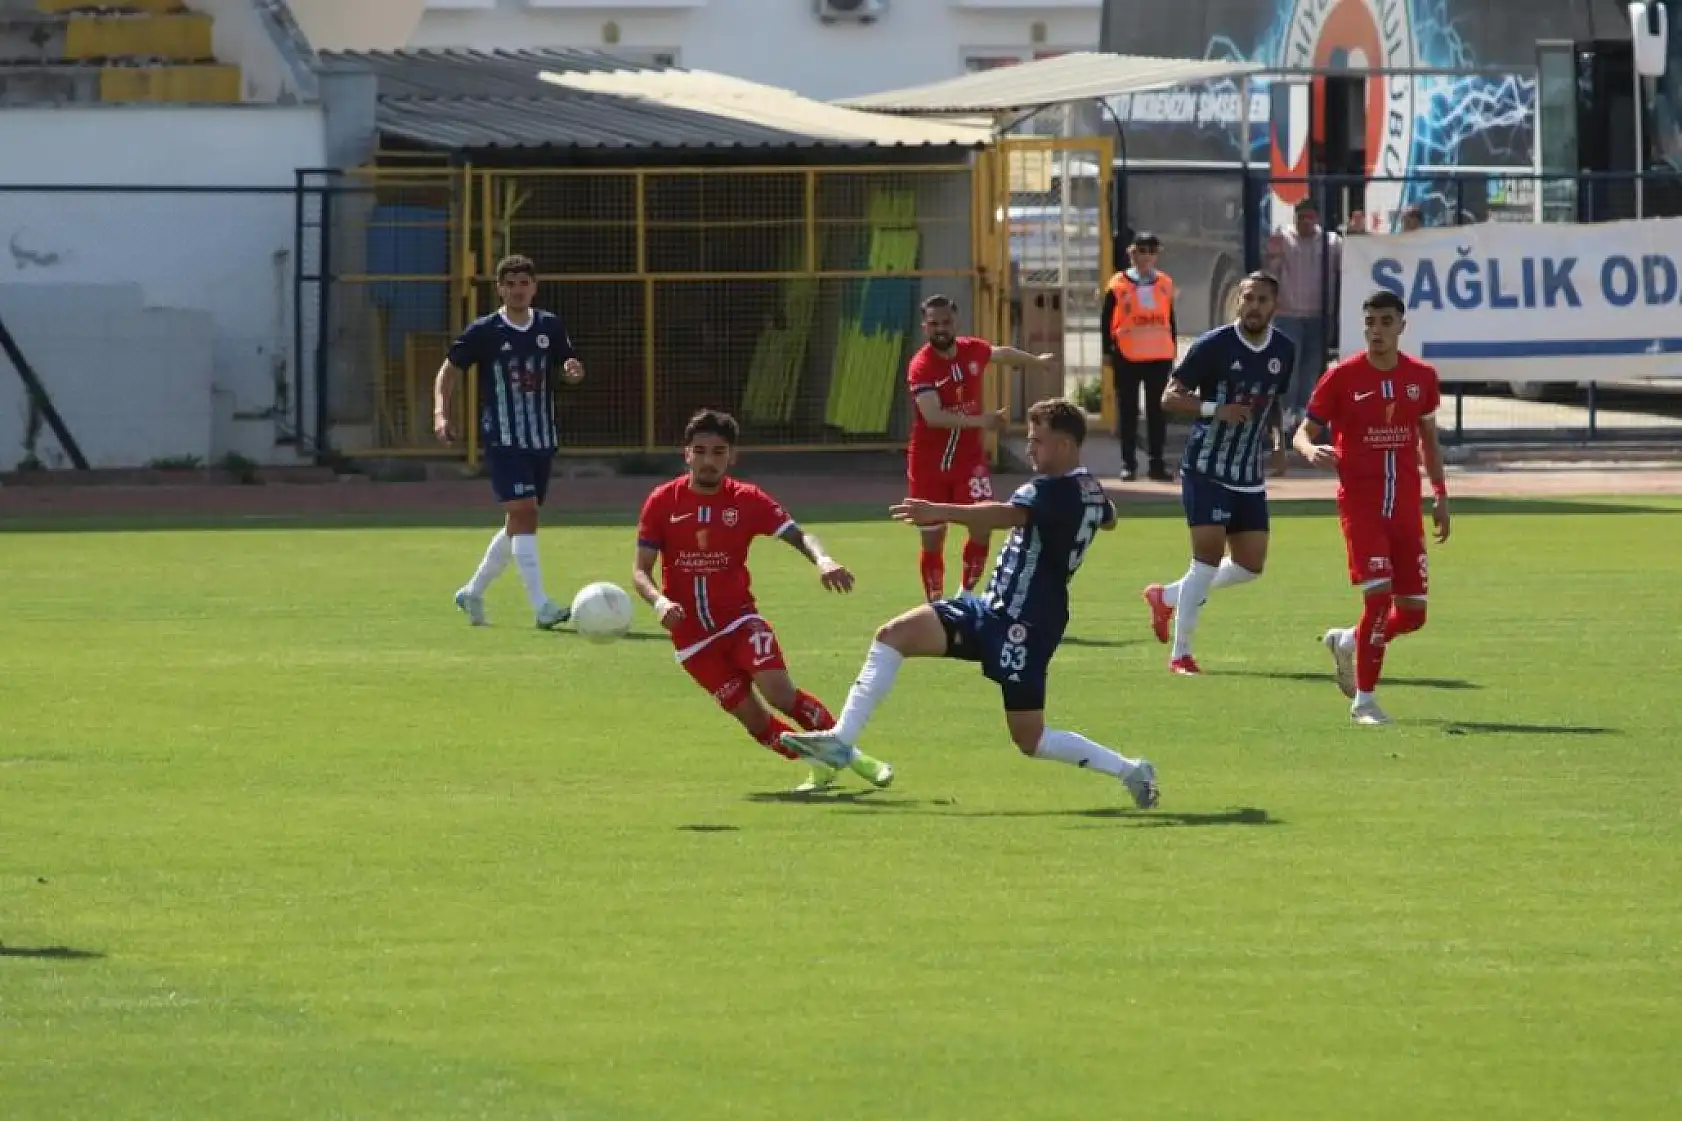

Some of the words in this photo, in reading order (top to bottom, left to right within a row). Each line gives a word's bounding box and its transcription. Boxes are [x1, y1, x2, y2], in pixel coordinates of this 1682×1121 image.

[1371, 245, 1582, 310] SAĞLIK
[1601, 255, 1682, 306] OD
[968, 476, 992, 498] 33
[748, 631, 773, 656] 17
[1000, 642, 1027, 670] 53
